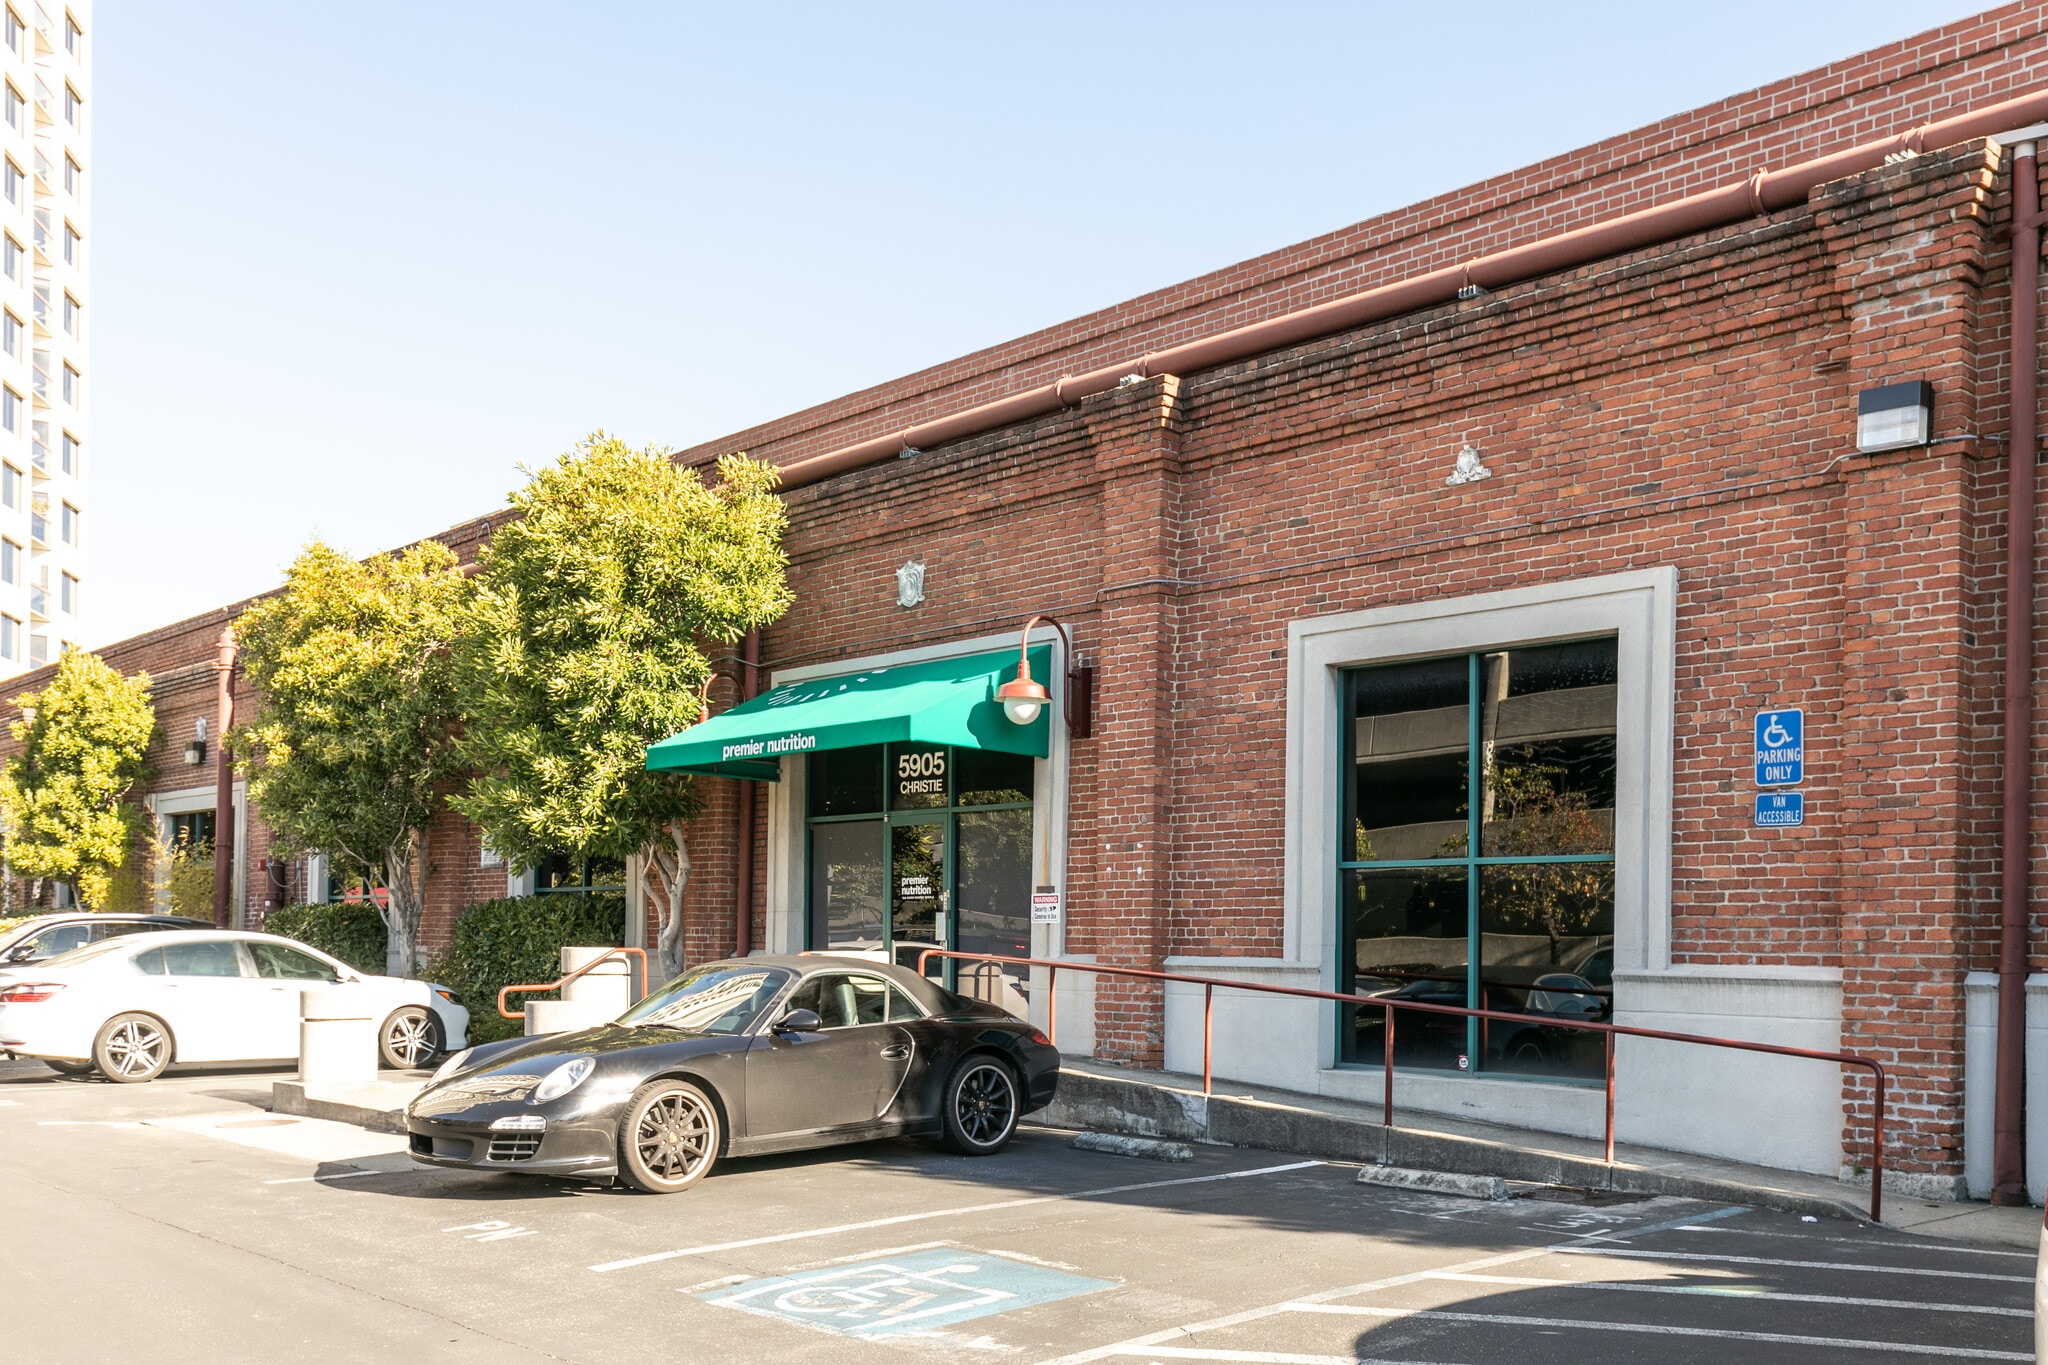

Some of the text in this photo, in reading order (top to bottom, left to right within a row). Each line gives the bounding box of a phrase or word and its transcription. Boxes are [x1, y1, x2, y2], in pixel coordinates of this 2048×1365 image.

[722, 733, 816, 761] premier nutrition
[1757, 747, 1801, 764] PARKING
[898, 751, 945, 778] 5905
[1765, 765, 1793, 780] ONLY
[900, 779, 943, 794] CHRISTIE
[1772, 796, 1786, 808] VAN
[1757, 810, 1800, 823] ACCESSIBLE
[901, 874, 929, 887] premier
[901, 884, 932, 895] nutrition
[1033, 896, 1058, 904] WARNING
